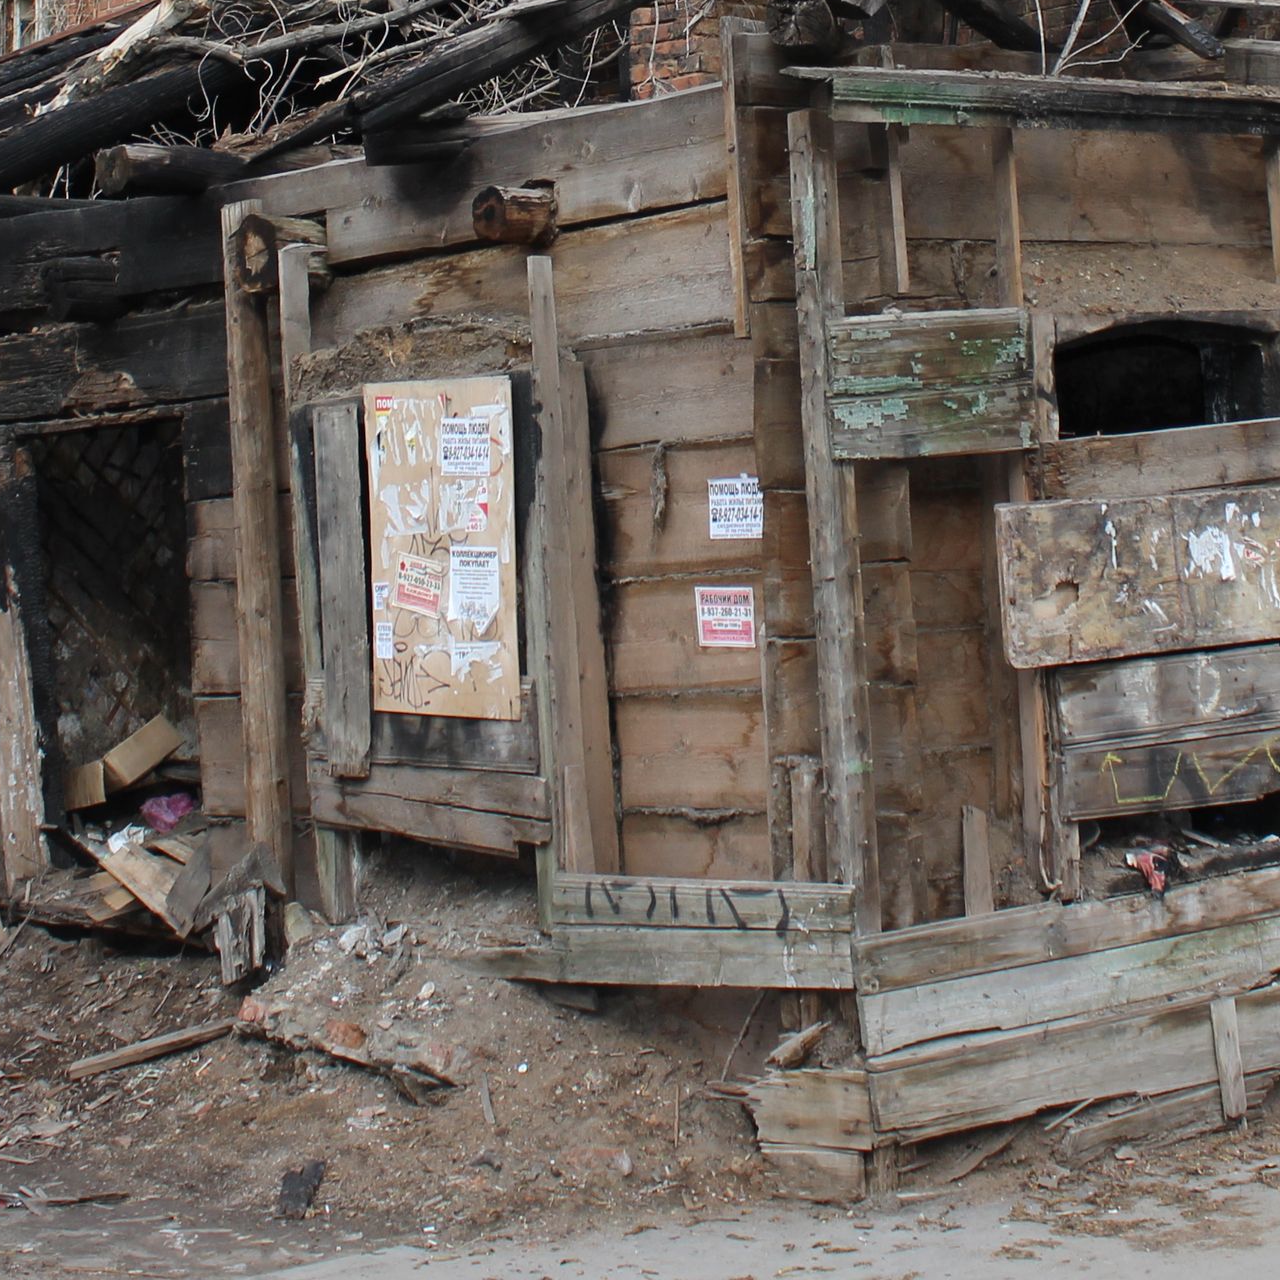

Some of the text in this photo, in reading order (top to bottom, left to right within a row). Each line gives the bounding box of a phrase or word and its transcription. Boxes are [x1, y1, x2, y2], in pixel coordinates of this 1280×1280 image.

[442, 423, 467, 436] ПОМОЩЬ
[710, 483, 739, 497] ПОМОЩЬ
[452, 550, 497, 560] КОЛЛЕКЦИОНЕР
[459, 560, 490, 569] ПОКУПАЕТ
[733, 594, 749, 605] ДОМ
